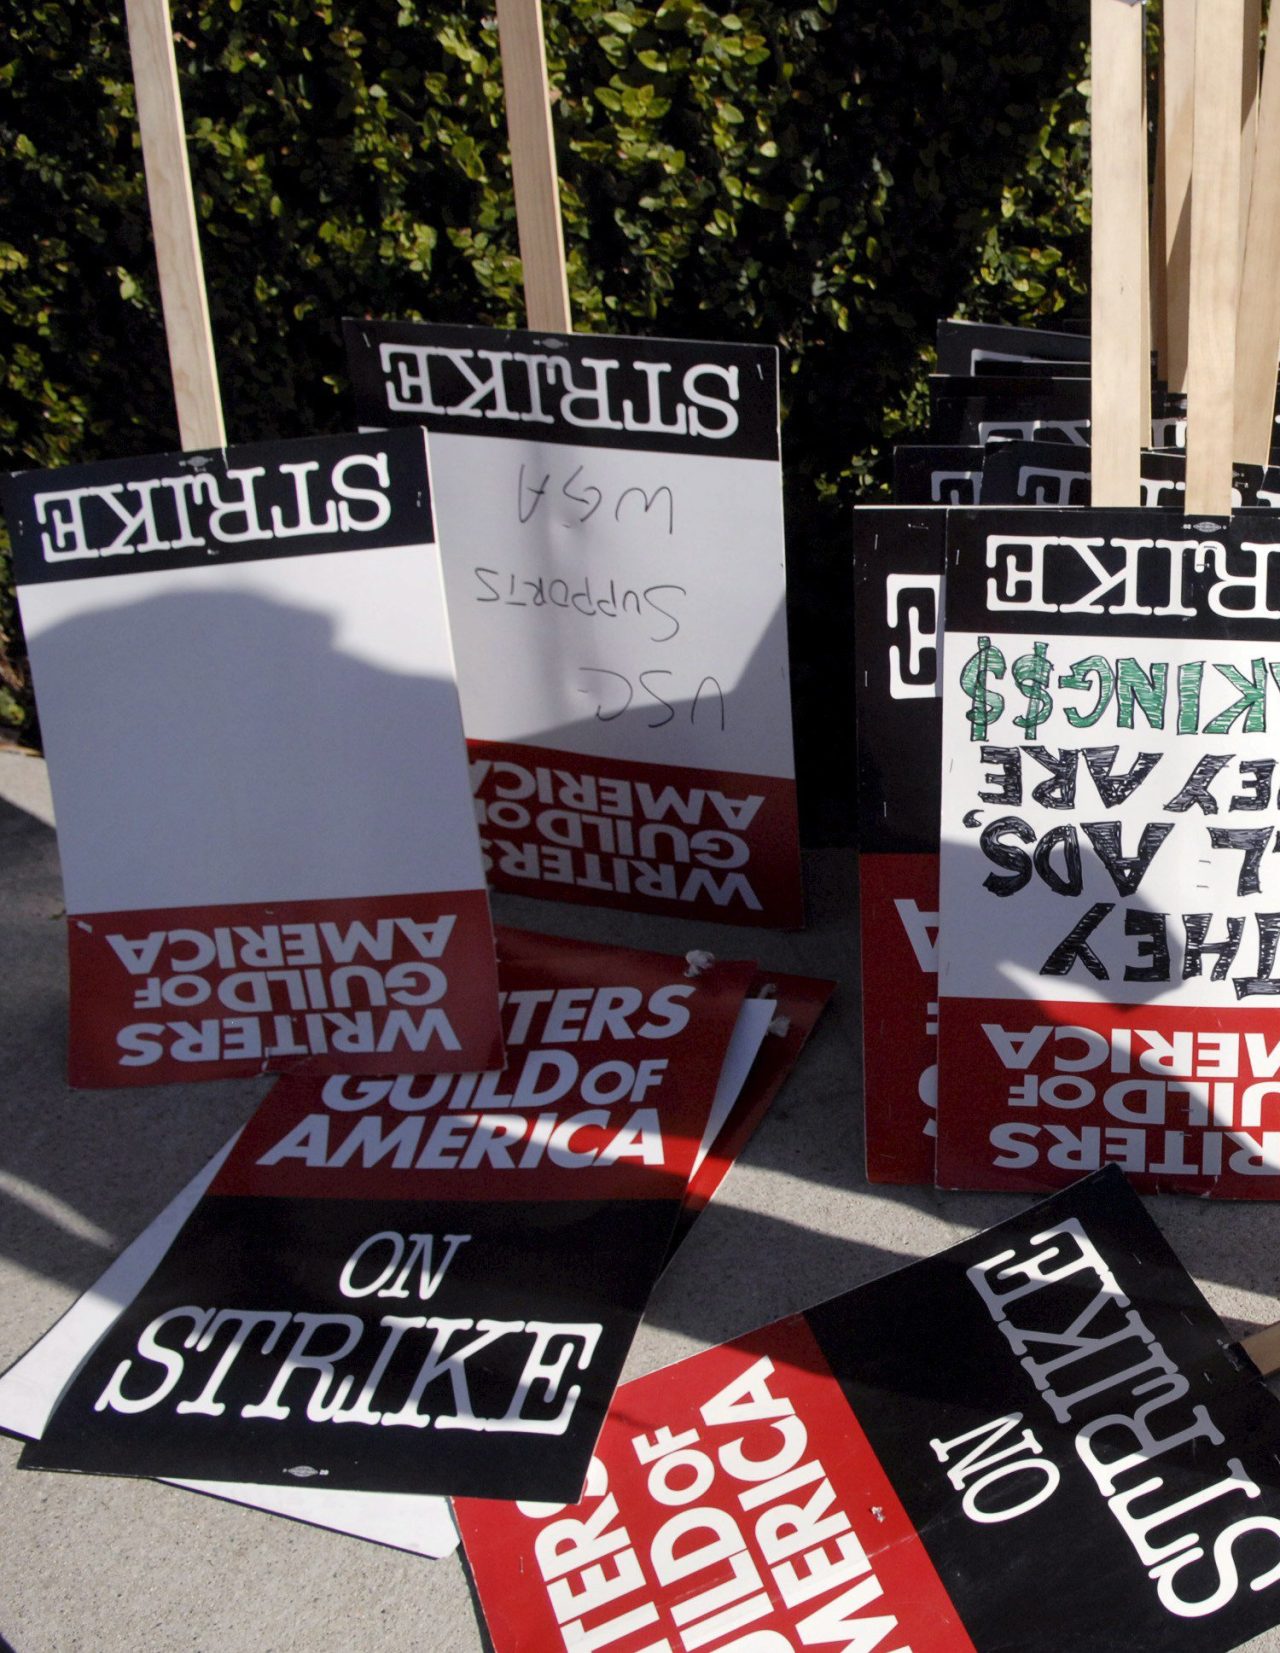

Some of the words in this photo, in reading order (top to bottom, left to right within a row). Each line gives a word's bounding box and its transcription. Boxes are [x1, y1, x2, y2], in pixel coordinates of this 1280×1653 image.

[379, 342, 740, 440] STRIKE
[33, 452, 392, 563] STRIKE
[578, 667, 724, 731] USC
[978, 744, 1165, 811] ARE
[536, 809, 750, 869] GUILD
[481, 839, 764, 911] WRITER
[105, 914, 458, 975] AMERICA
[133, 974, 211, 1009] OF
[217, 961, 448, 1013] GUILD
[499, 984, 697, 1045] TERS
[116, 1008, 463, 1067] WRITERS
[322, 1049, 580, 1112] GUILD
[580, 1058, 669, 1105] OF
[1008, 1073, 1096, 1109] OF
[255, 1107, 665, 1169] AMERICA
[339, 1230, 470, 1300] ON
[93, 1305, 603, 1437] STRIKE
[631, 1425, 715, 1507] OF
[929, 1411, 1061, 1525] ON
[699, 1354, 914, 1653] MERICA
